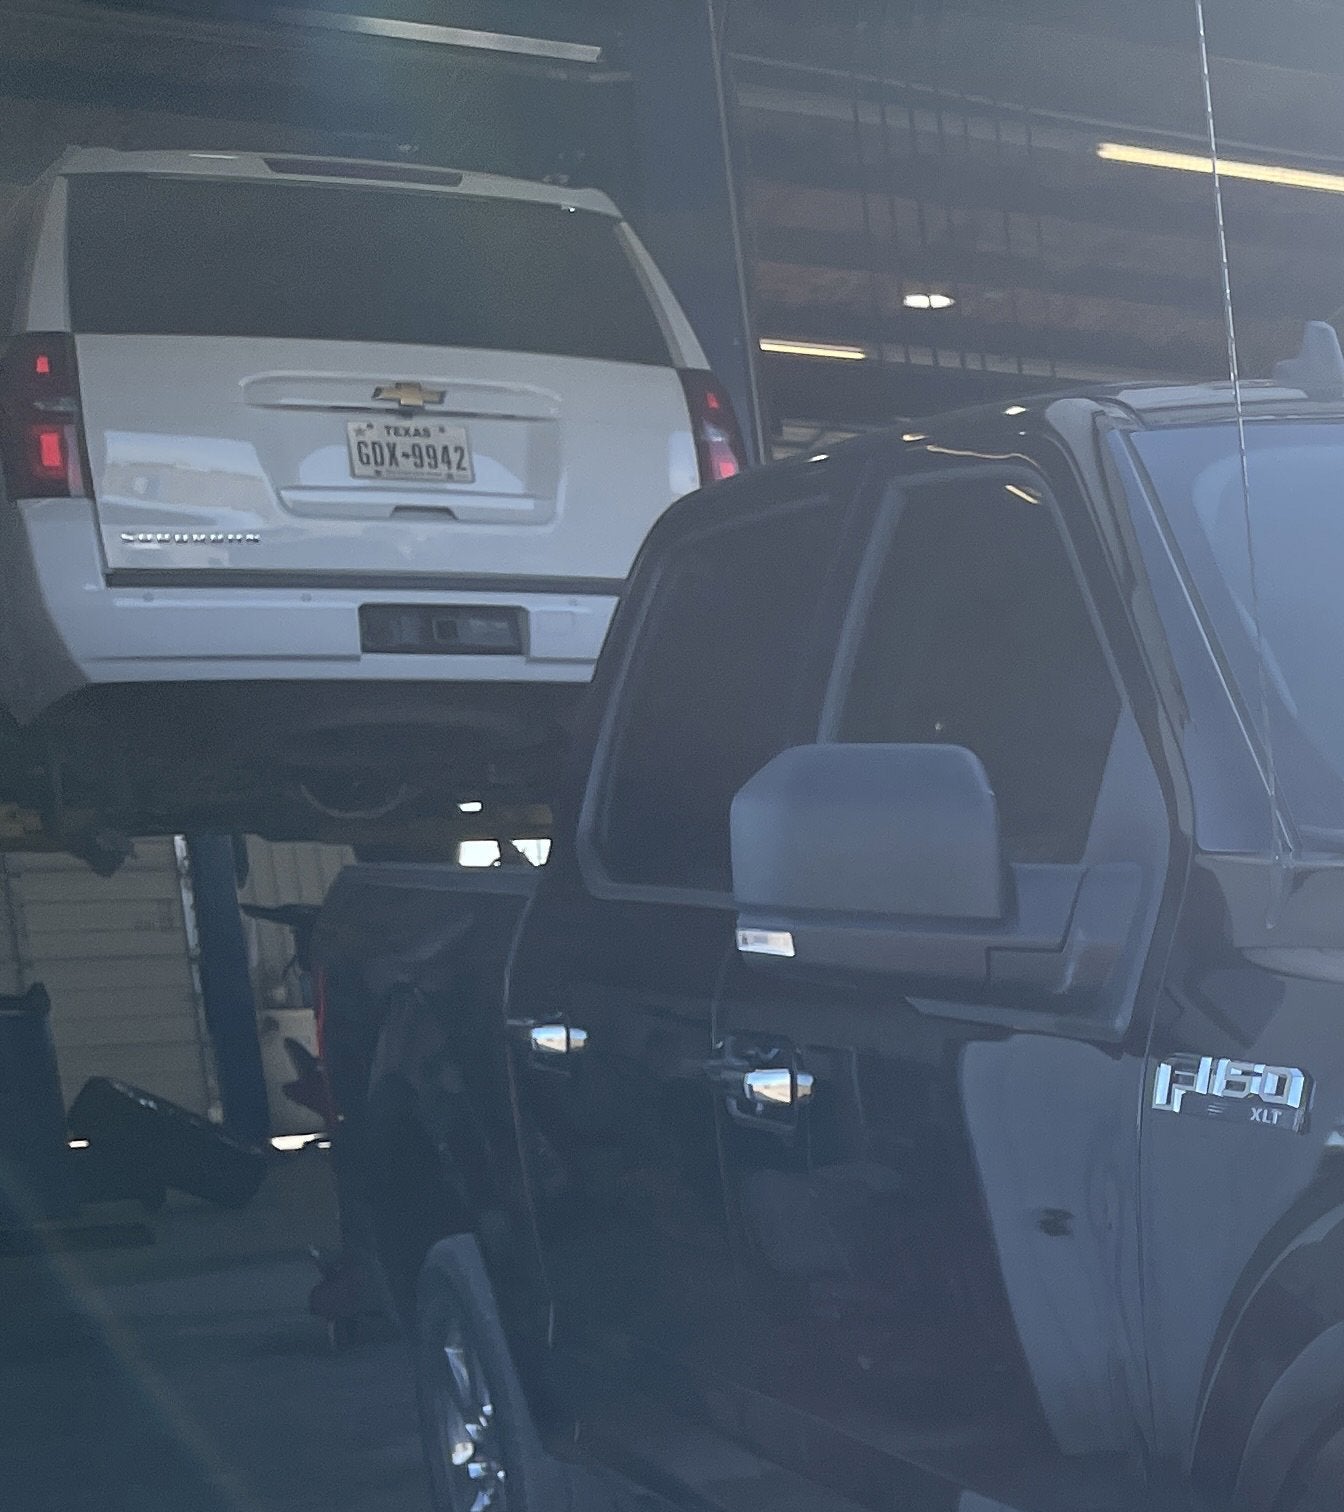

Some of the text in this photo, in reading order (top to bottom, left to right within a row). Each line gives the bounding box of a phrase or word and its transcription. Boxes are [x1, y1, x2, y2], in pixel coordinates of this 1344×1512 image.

[384, 425, 432, 438] TEXAS
[356, 440, 467, 472] GDX-9942
[1250, 1106, 1282, 1125] XLT
